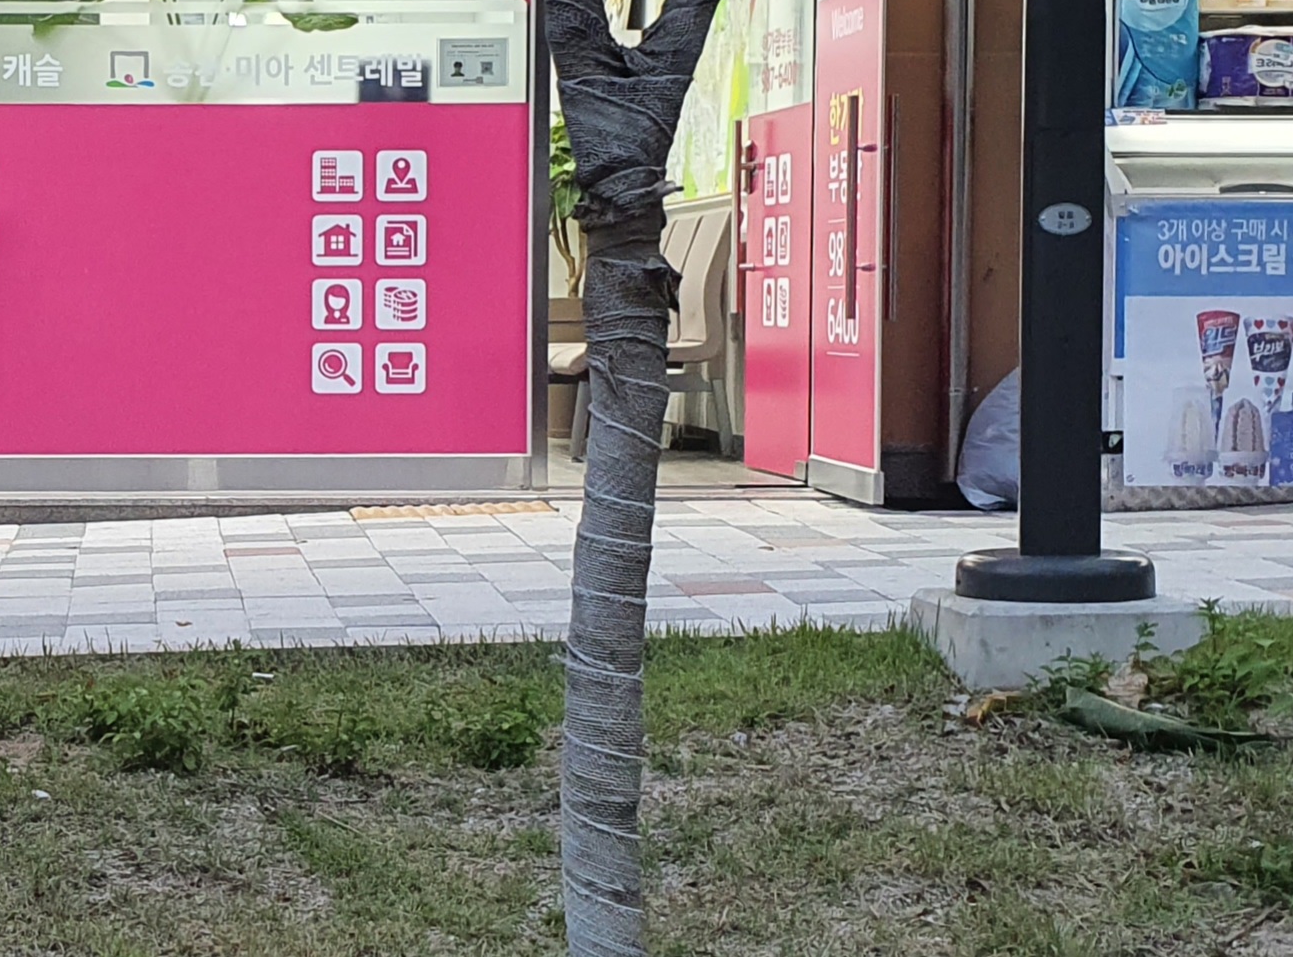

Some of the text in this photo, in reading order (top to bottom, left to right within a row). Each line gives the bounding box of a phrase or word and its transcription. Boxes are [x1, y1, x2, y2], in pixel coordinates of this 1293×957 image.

[830, 6, 864, 41] Welcome
[2, 53, 64, 87] 캐슬
[303, 53, 424, 88] 센트레빌
[1157, 219, 1288, 242] 3개 이상 구매 시
[1157, 243, 1287, 276] 아이스크림
